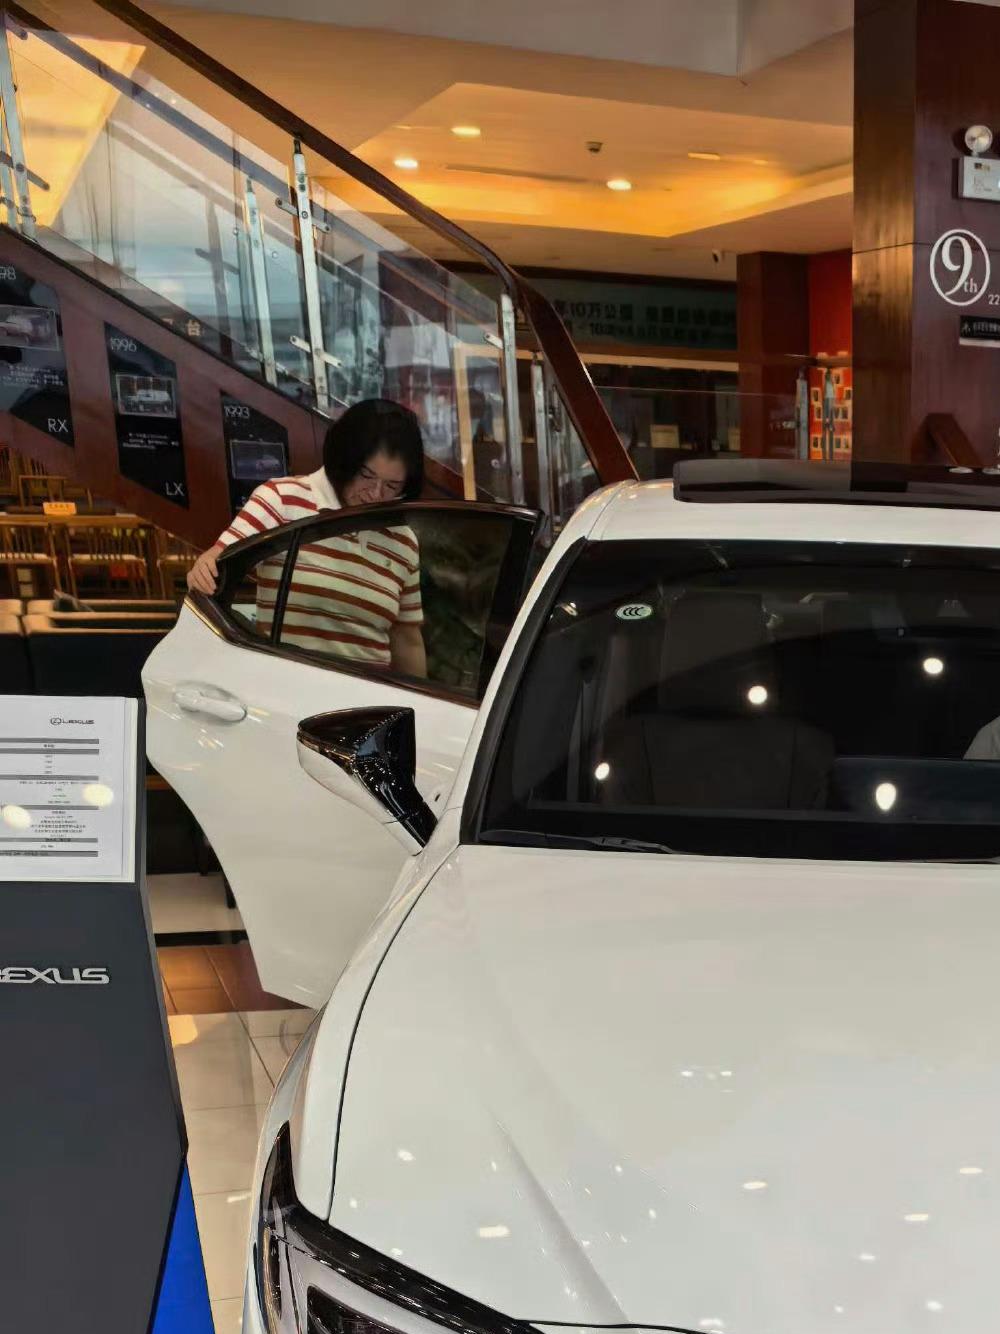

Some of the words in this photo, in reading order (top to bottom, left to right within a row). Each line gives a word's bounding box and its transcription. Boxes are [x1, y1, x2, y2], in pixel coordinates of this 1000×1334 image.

[109, 337, 137, 352] 1996
[47, 418, 69, 433] RX
[166, 482, 185, 497] LX
[0, 967, 110, 984] EXUS
